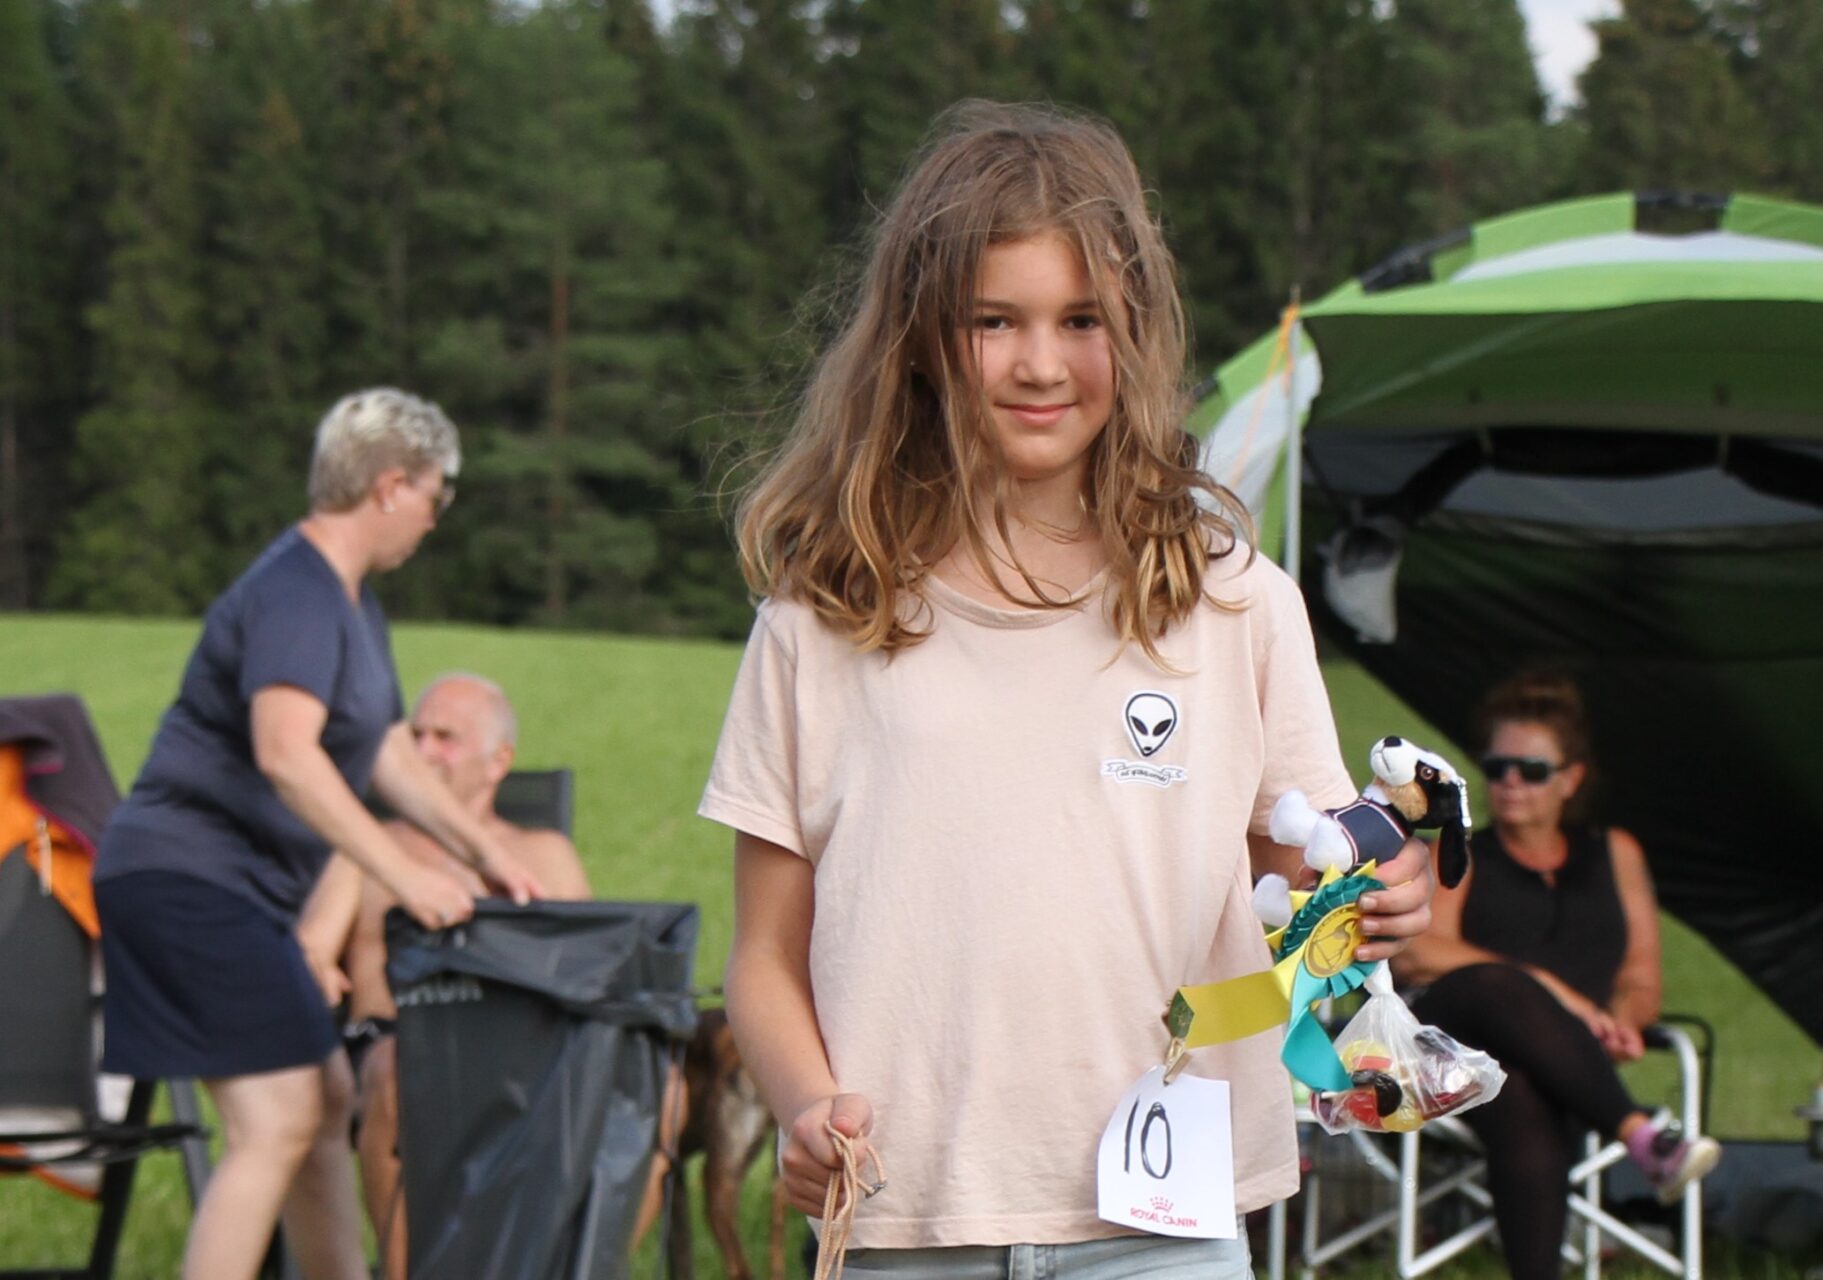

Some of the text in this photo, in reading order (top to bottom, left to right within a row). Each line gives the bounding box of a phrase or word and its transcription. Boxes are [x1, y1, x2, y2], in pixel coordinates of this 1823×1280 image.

[1123, 1095, 1173, 1180] 10
[1129, 1207, 1199, 1228] ROYAL CANIN
